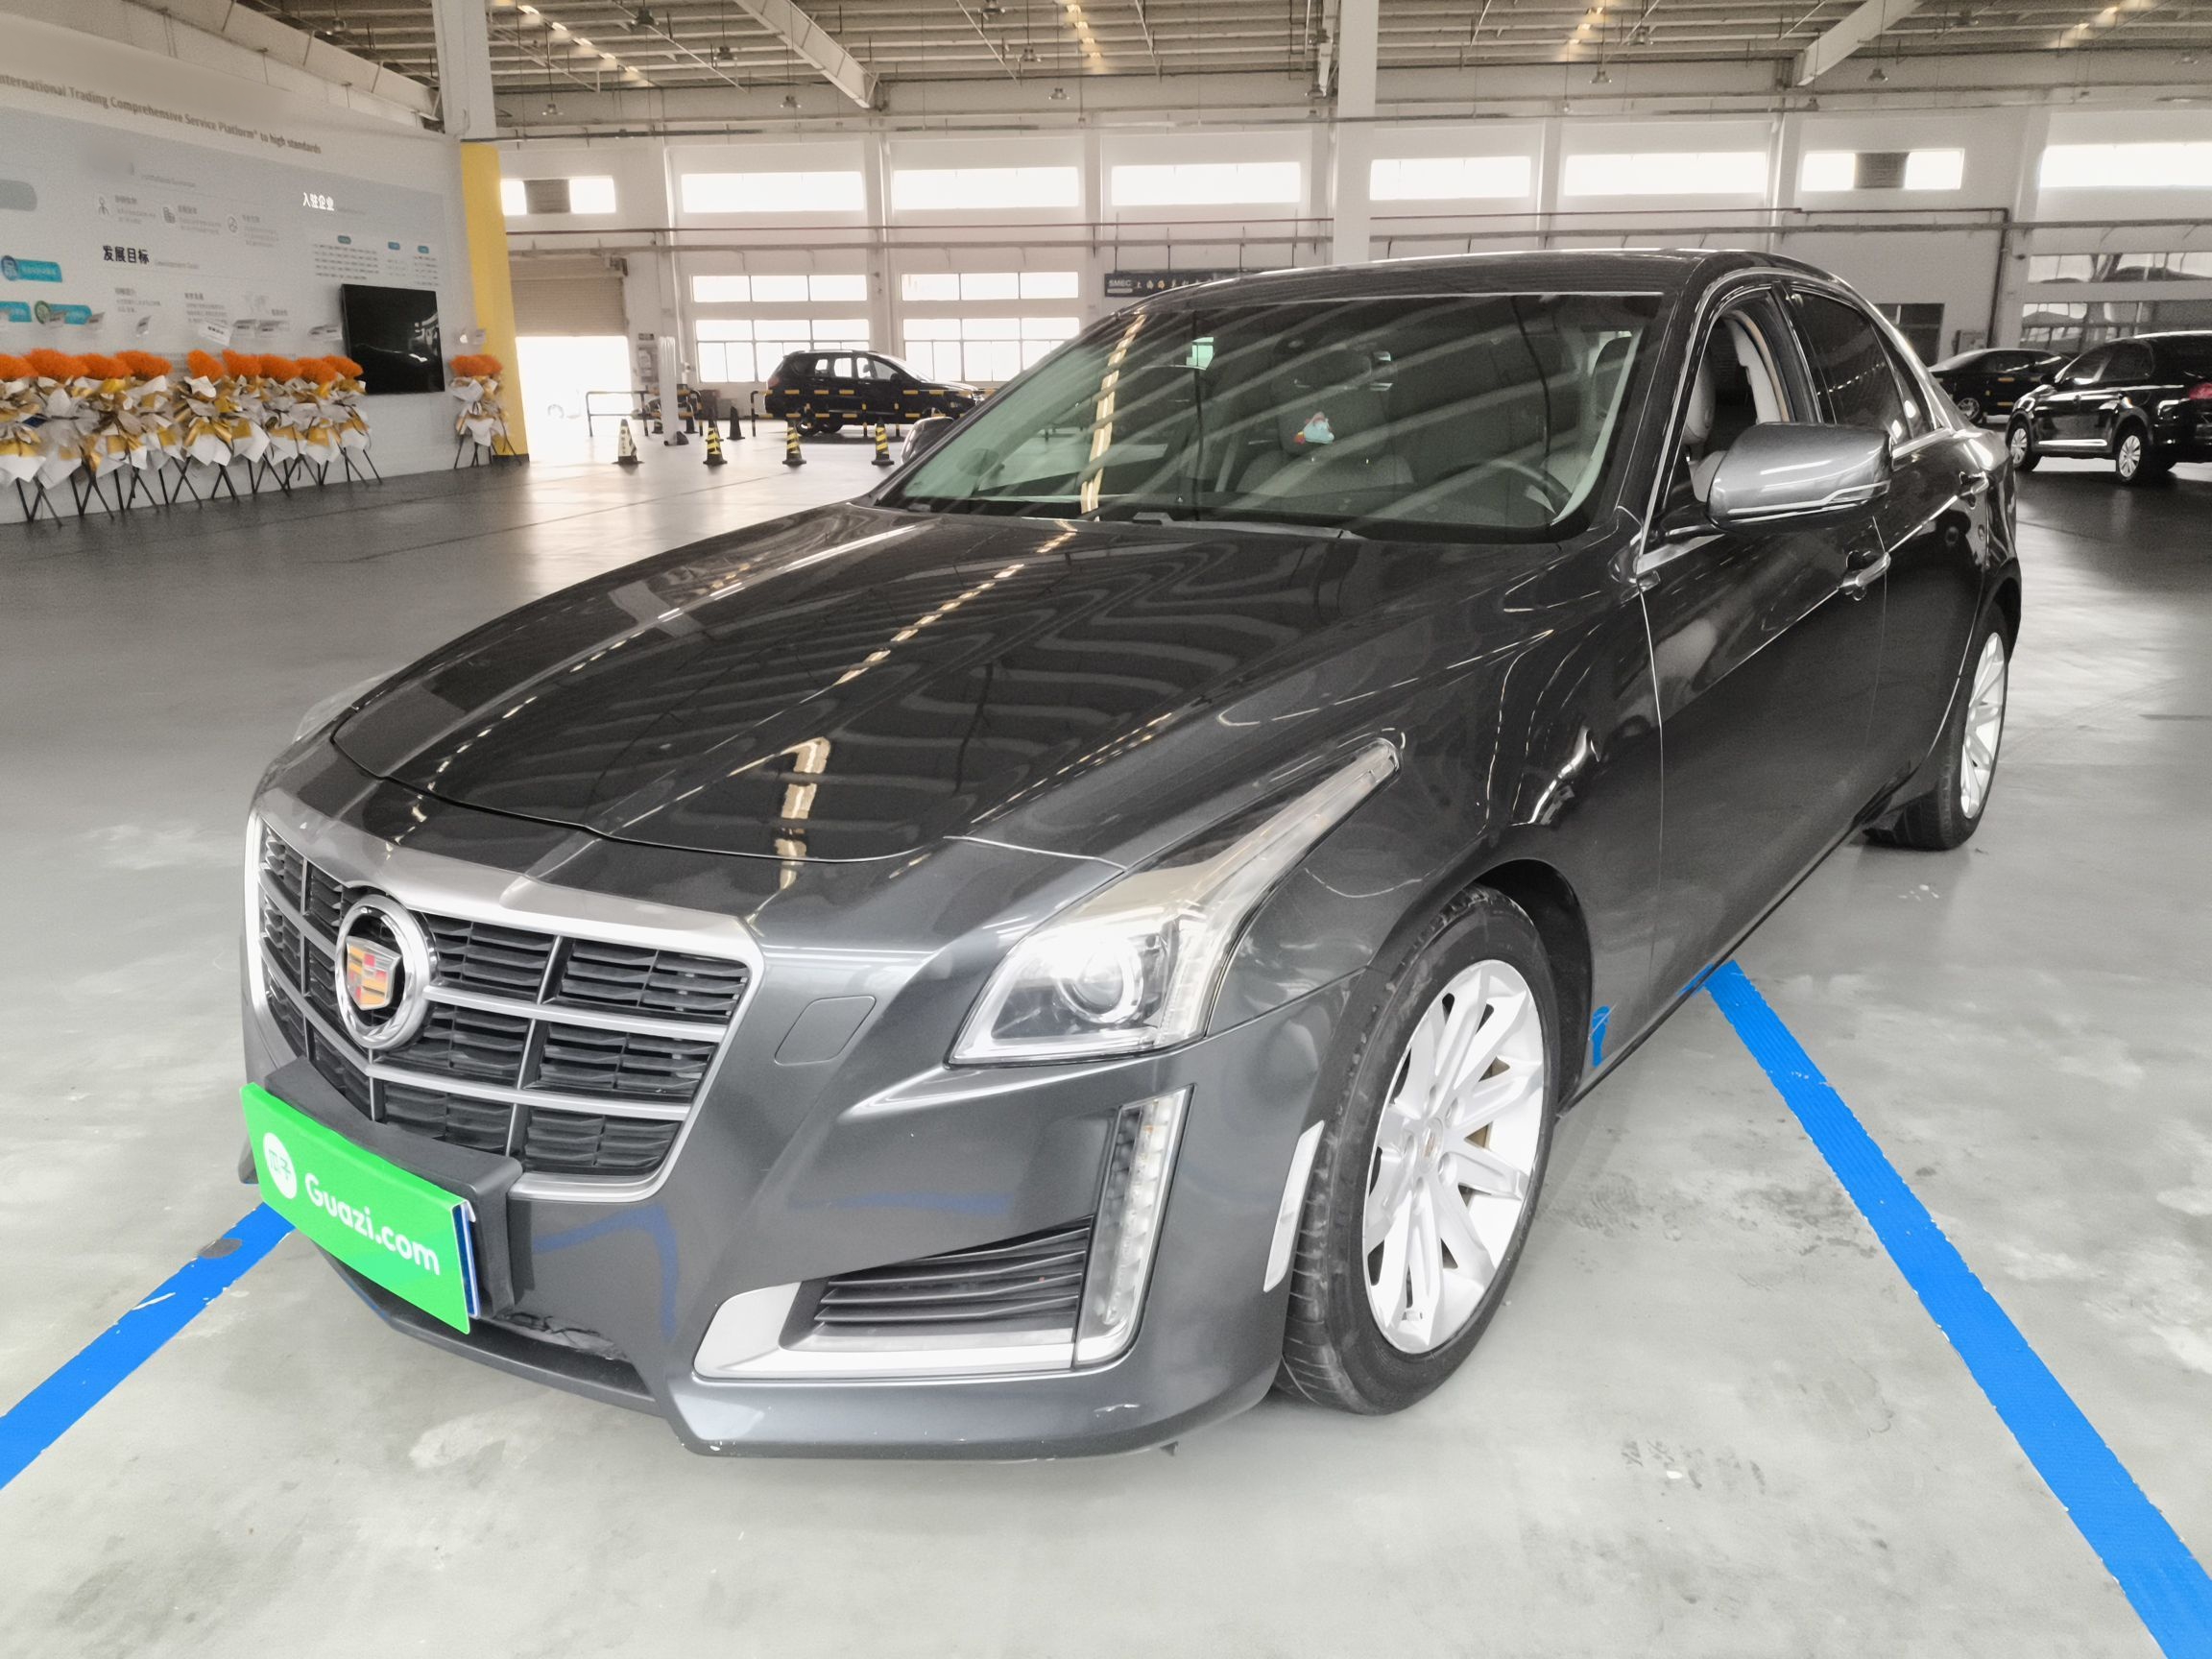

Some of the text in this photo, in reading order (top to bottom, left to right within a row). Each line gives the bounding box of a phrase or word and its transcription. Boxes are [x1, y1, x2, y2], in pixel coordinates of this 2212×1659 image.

[0, 74, 66, 97] nternational
[69, 85, 109, 109] Trading
[110, 97, 183, 123] Comprehensive
[184, 113, 217, 132] Service
[260, 132, 269, 143] to
[103, 245, 150, 265] 发展目标
[304, 1172, 441, 1276] Guazi.com
